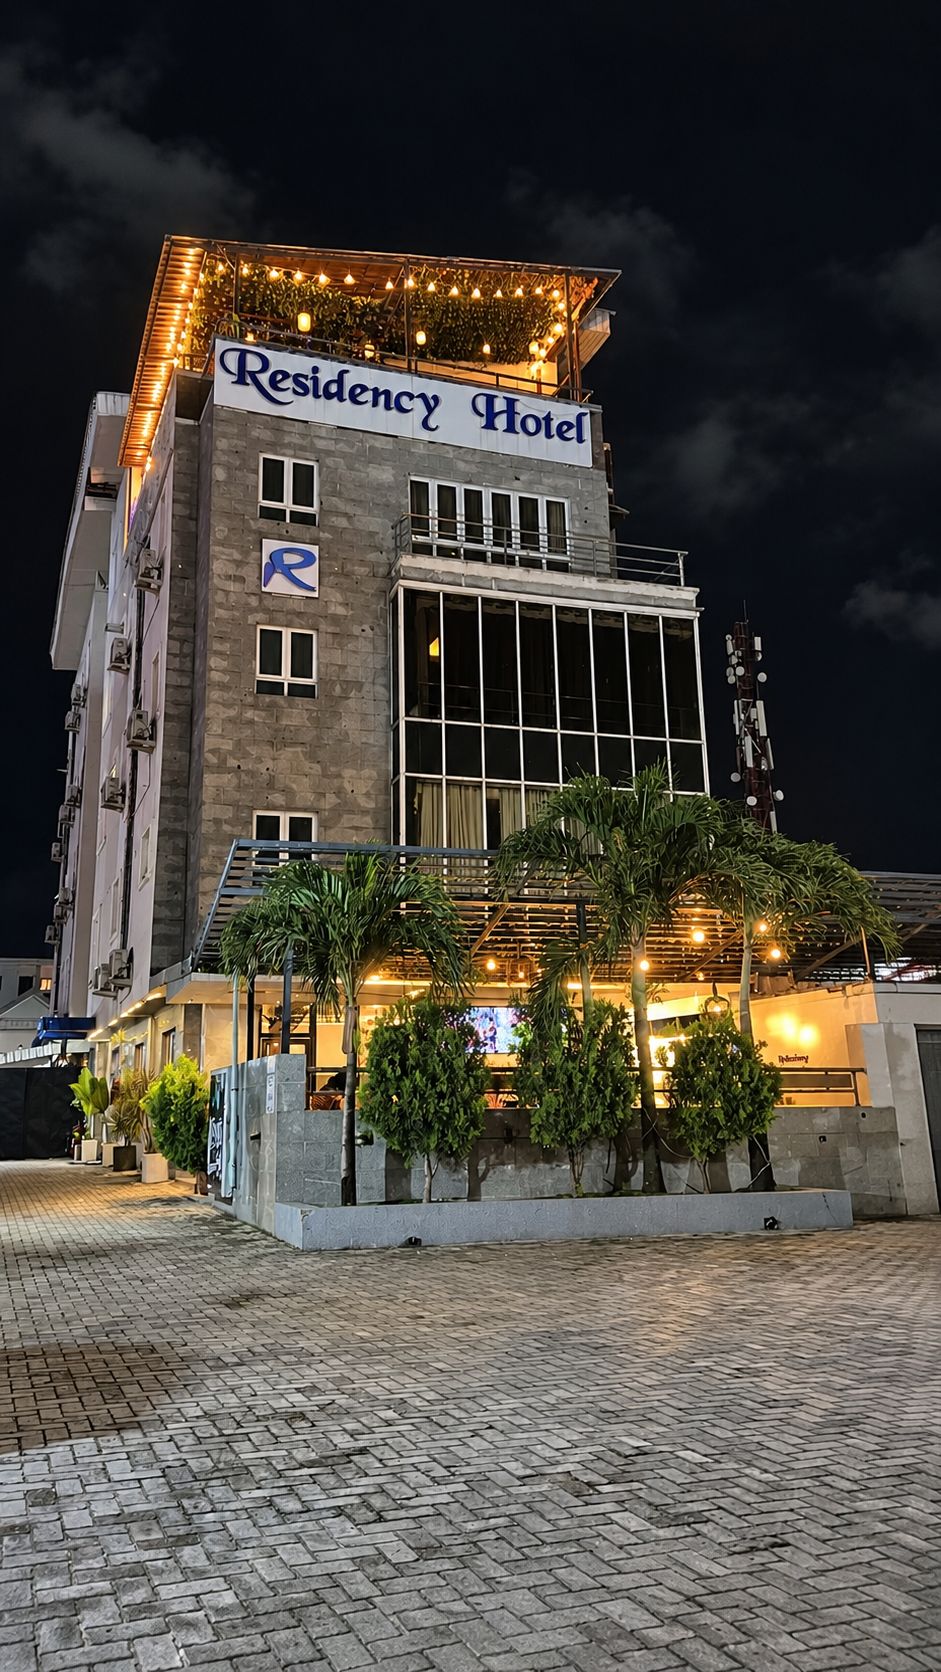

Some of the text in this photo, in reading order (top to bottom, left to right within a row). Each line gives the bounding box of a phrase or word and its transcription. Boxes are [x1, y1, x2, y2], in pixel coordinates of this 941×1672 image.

[220, 348, 588, 442] Residency Hotel
[263, 548, 316, 592] R
